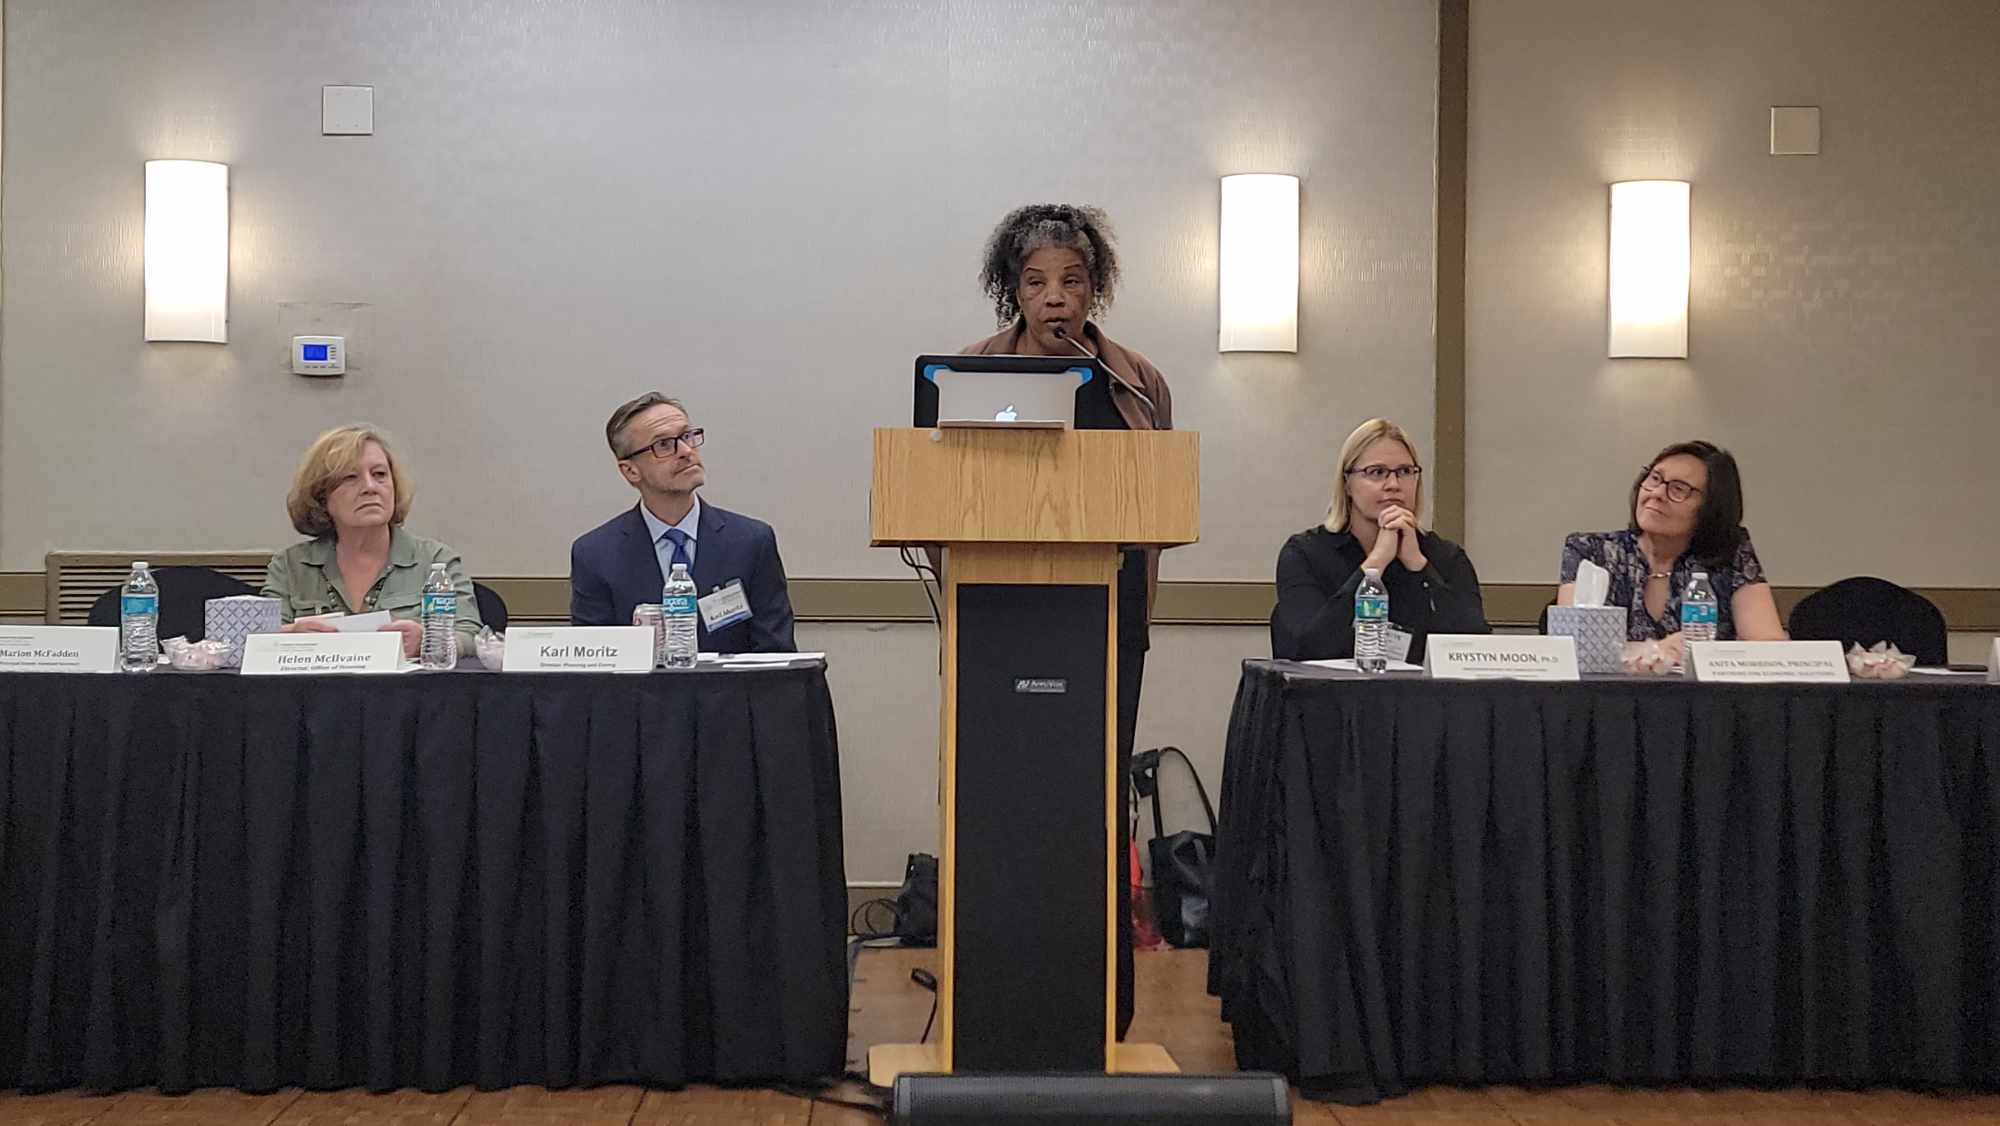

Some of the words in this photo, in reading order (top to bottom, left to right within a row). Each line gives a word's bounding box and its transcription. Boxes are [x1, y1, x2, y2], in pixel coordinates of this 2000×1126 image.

[0, 649, 32, 657] Marion
[34, 649, 79, 657] McFadden
[540, 646, 569, 657] Karl
[573, 646, 618, 657] Moritz
[278, 654, 312, 664] Helen
[315, 653, 371, 663] McIlvaine
[1448, 652, 1497, 662] KRYSTYN
